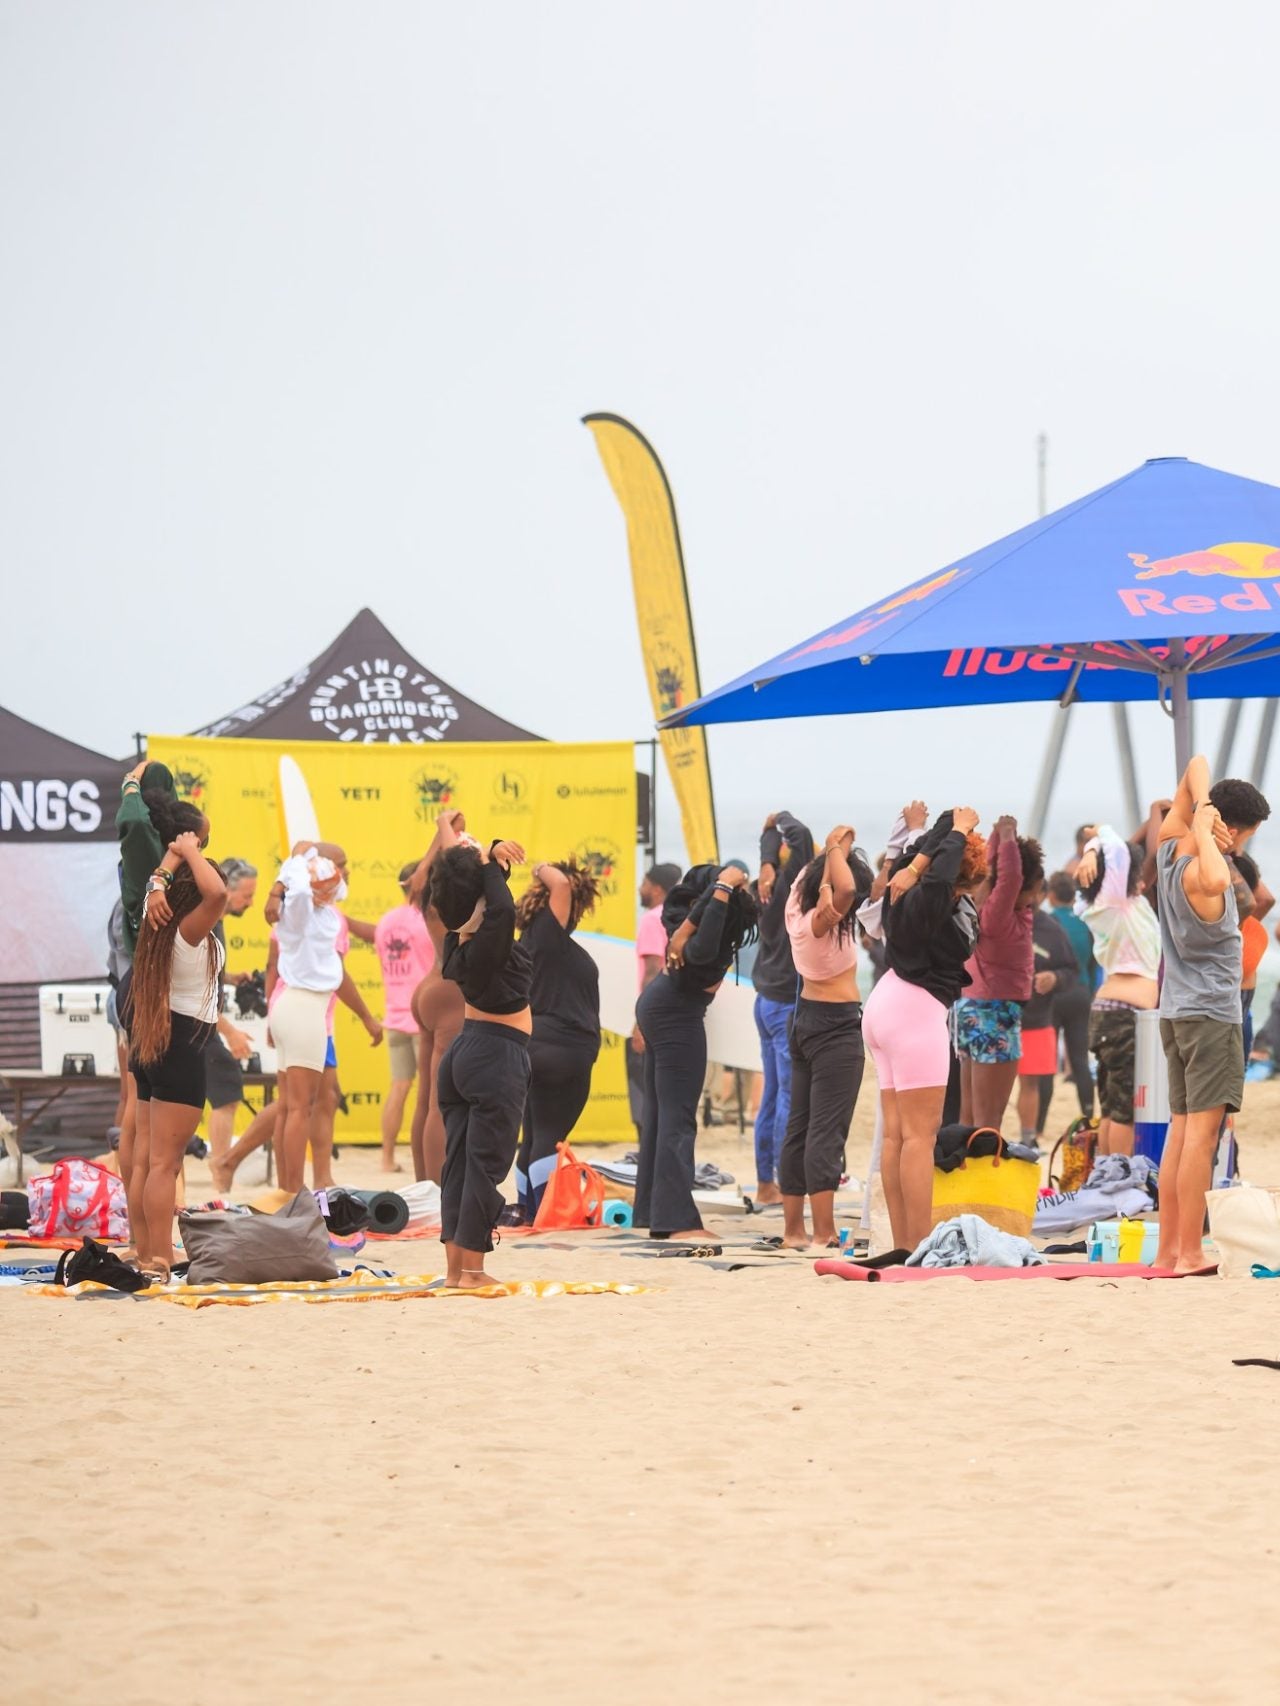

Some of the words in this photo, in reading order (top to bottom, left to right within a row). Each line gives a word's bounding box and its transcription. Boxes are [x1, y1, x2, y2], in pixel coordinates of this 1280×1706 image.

[1116, 582, 1271, 617] Red
[309, 658, 453, 707] HUNTINGTON
[310, 700, 459, 722] BOARDRIDERS
[363, 715, 414, 731] CLUB
[0, 779, 102, 833] NGS
[340, 787, 381, 801] YETI
